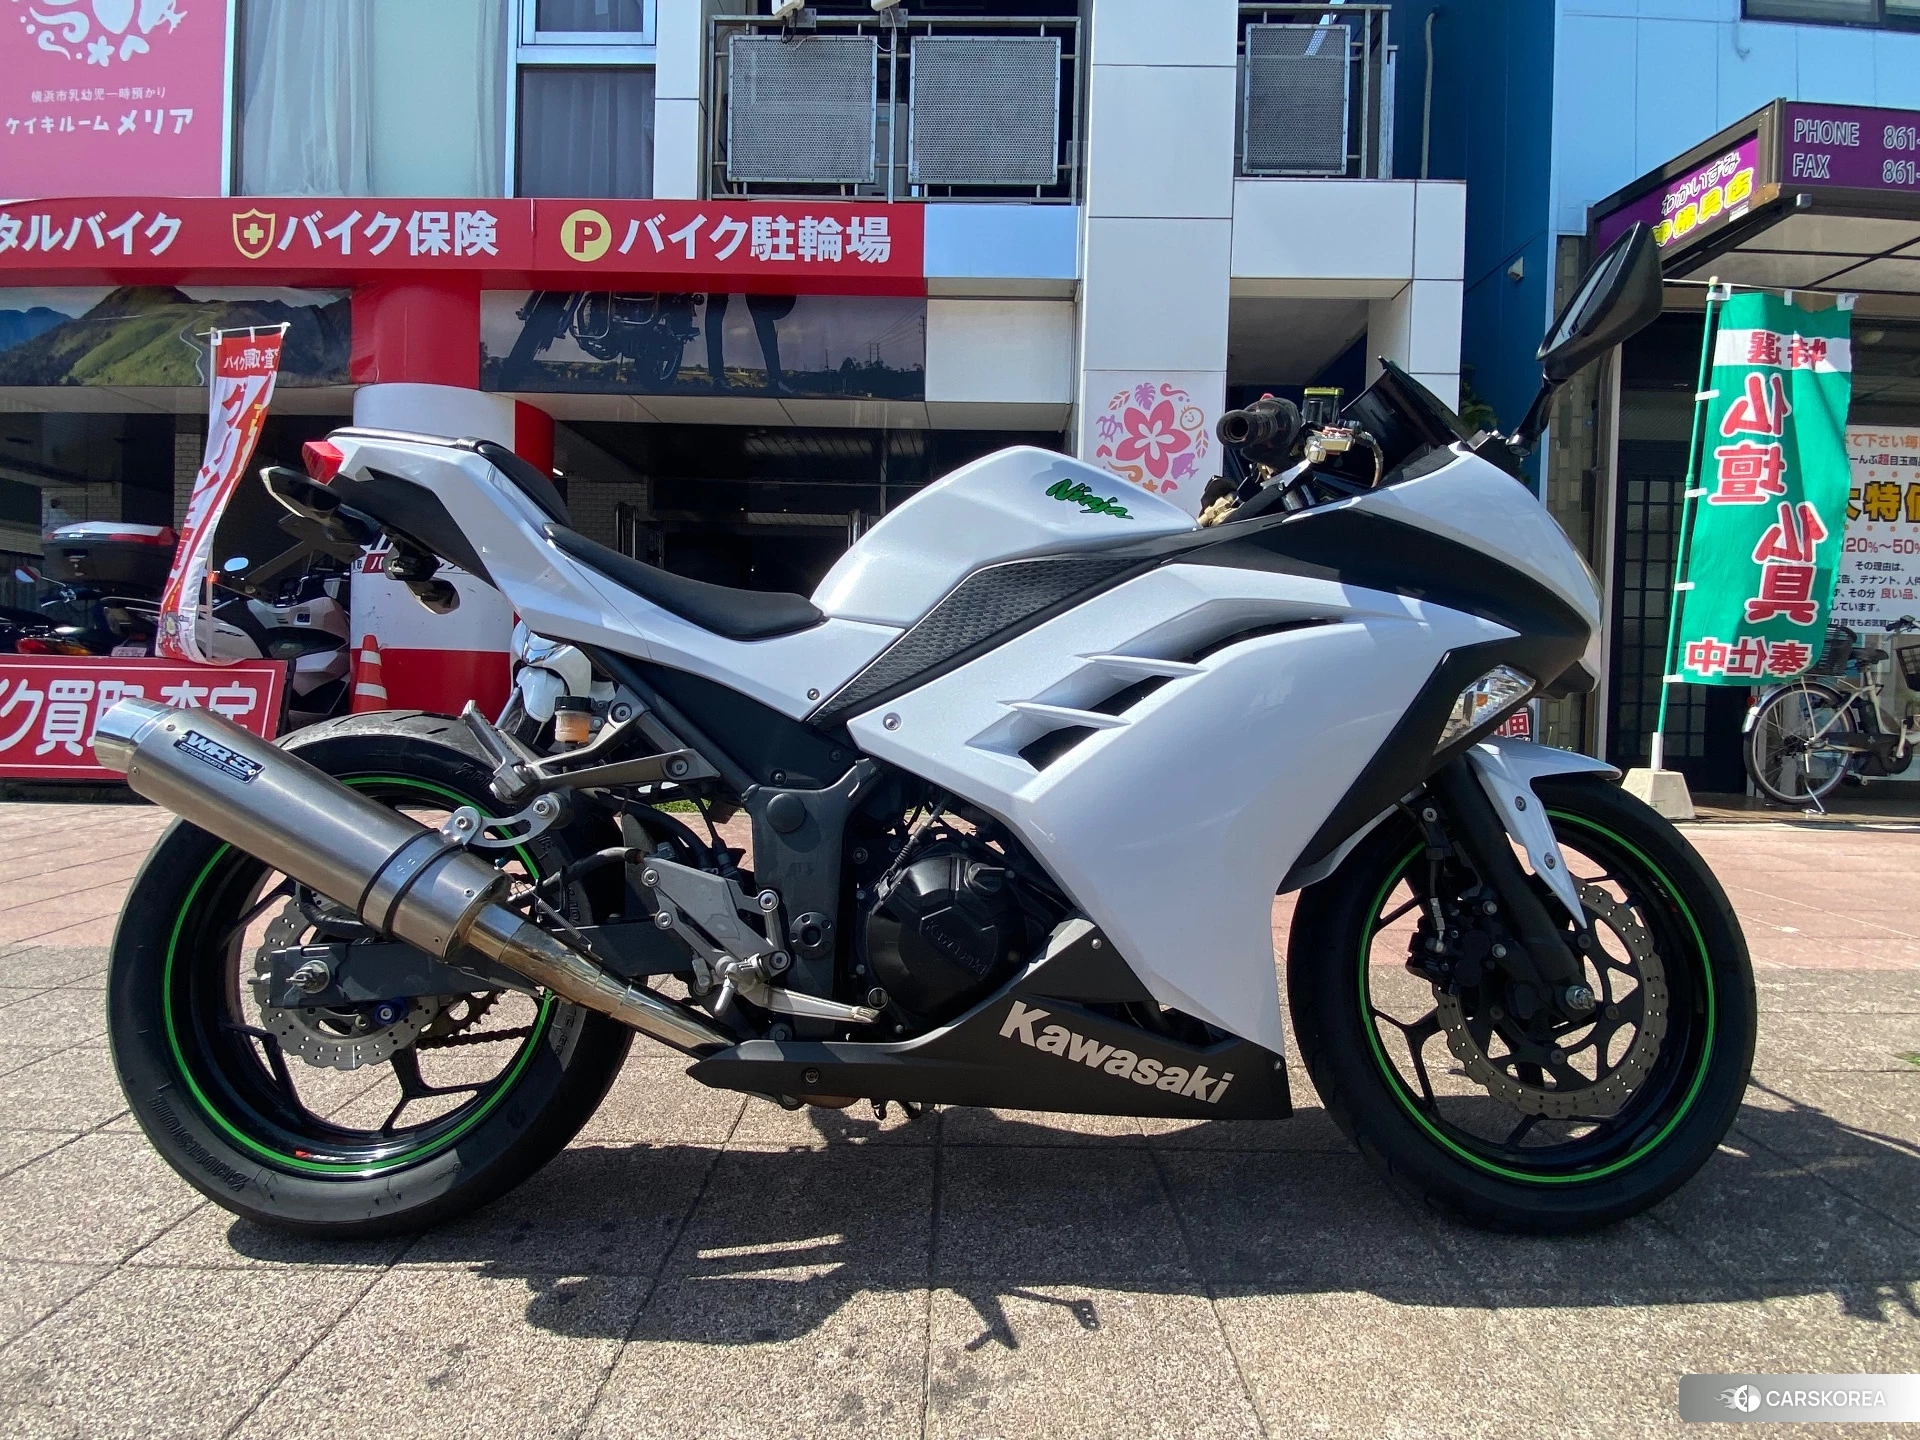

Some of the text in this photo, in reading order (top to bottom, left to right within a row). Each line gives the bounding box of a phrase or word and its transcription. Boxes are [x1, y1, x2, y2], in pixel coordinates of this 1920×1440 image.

[6, 108, 194, 136] ケイキルーム メリア
[1794, 118, 1860, 147] PHONE
[1793, 153, 1831, 179] FAX
[277, 210, 499, 257] バイク保険
[574, 213, 892, 264] P バイク駐輪場
[1045, 478, 1134, 519] Ninja
[999, 1000, 1235, 1104] Kawasaki
